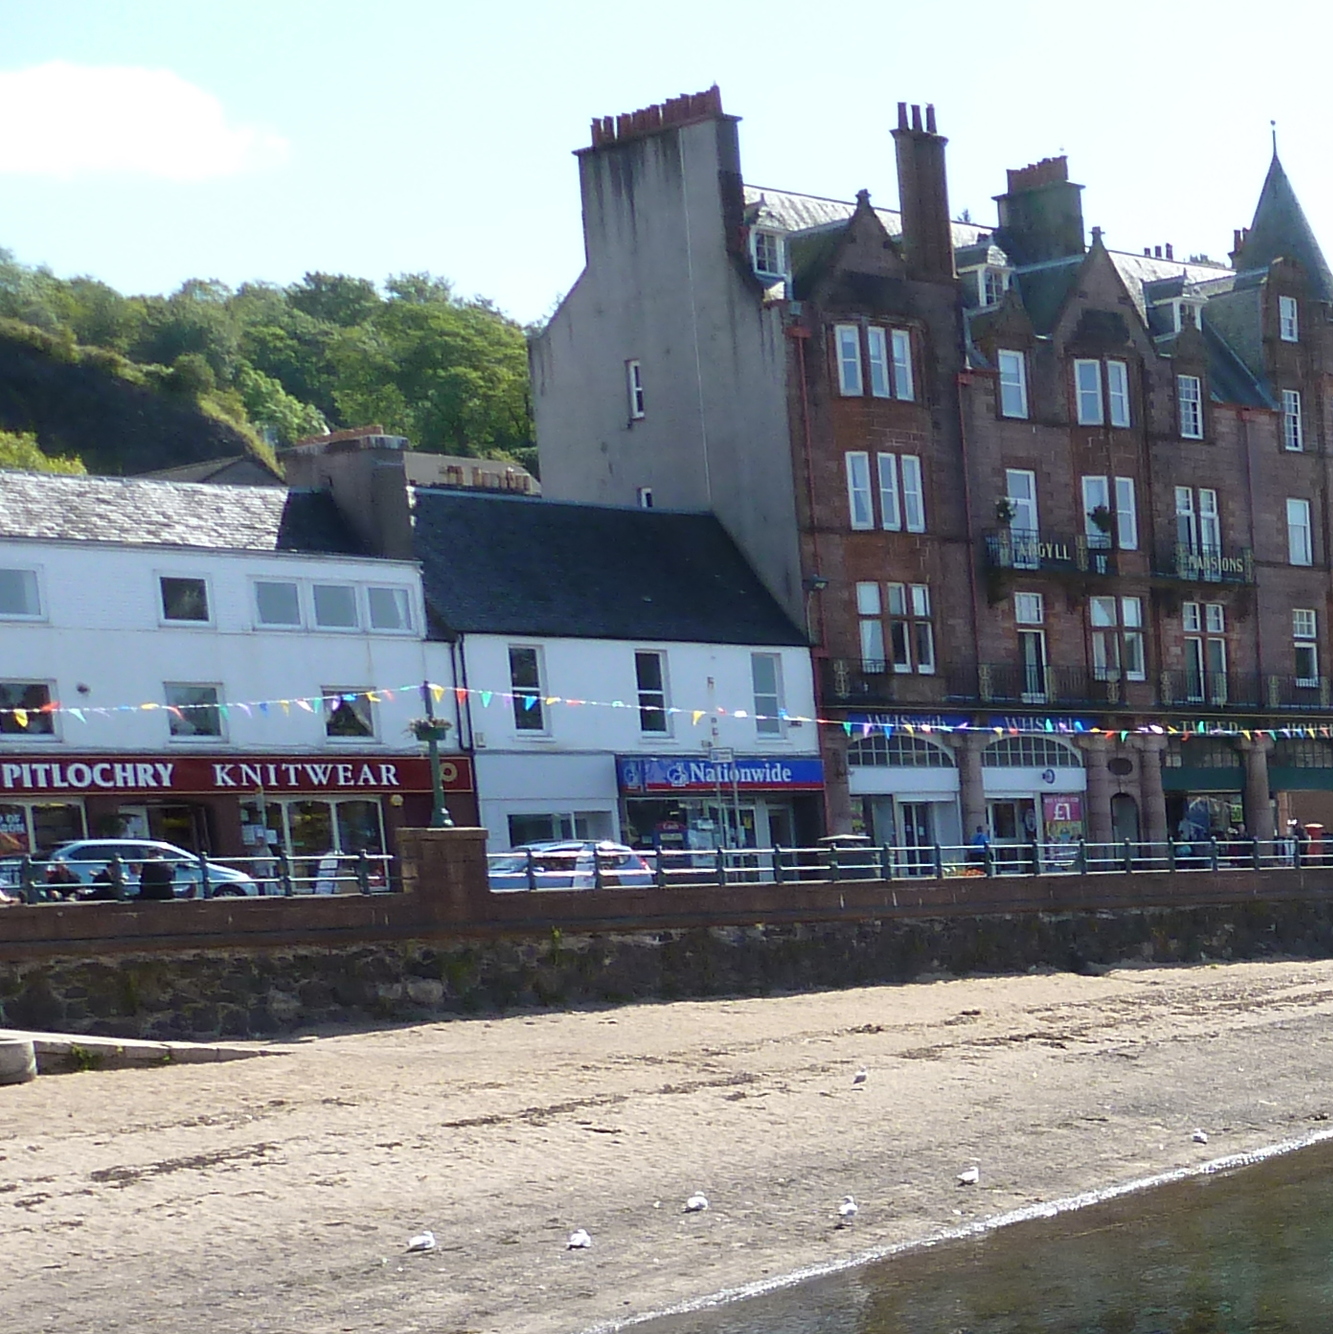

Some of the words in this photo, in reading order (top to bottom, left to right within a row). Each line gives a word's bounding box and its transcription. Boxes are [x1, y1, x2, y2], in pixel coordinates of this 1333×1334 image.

[2, 762, 173, 788] PITLOCHRY
[212, 762, 400, 787] KNITWEAR
[691, 762, 792, 783] Nationwide
[1053, 803, 1071, 821] £1
